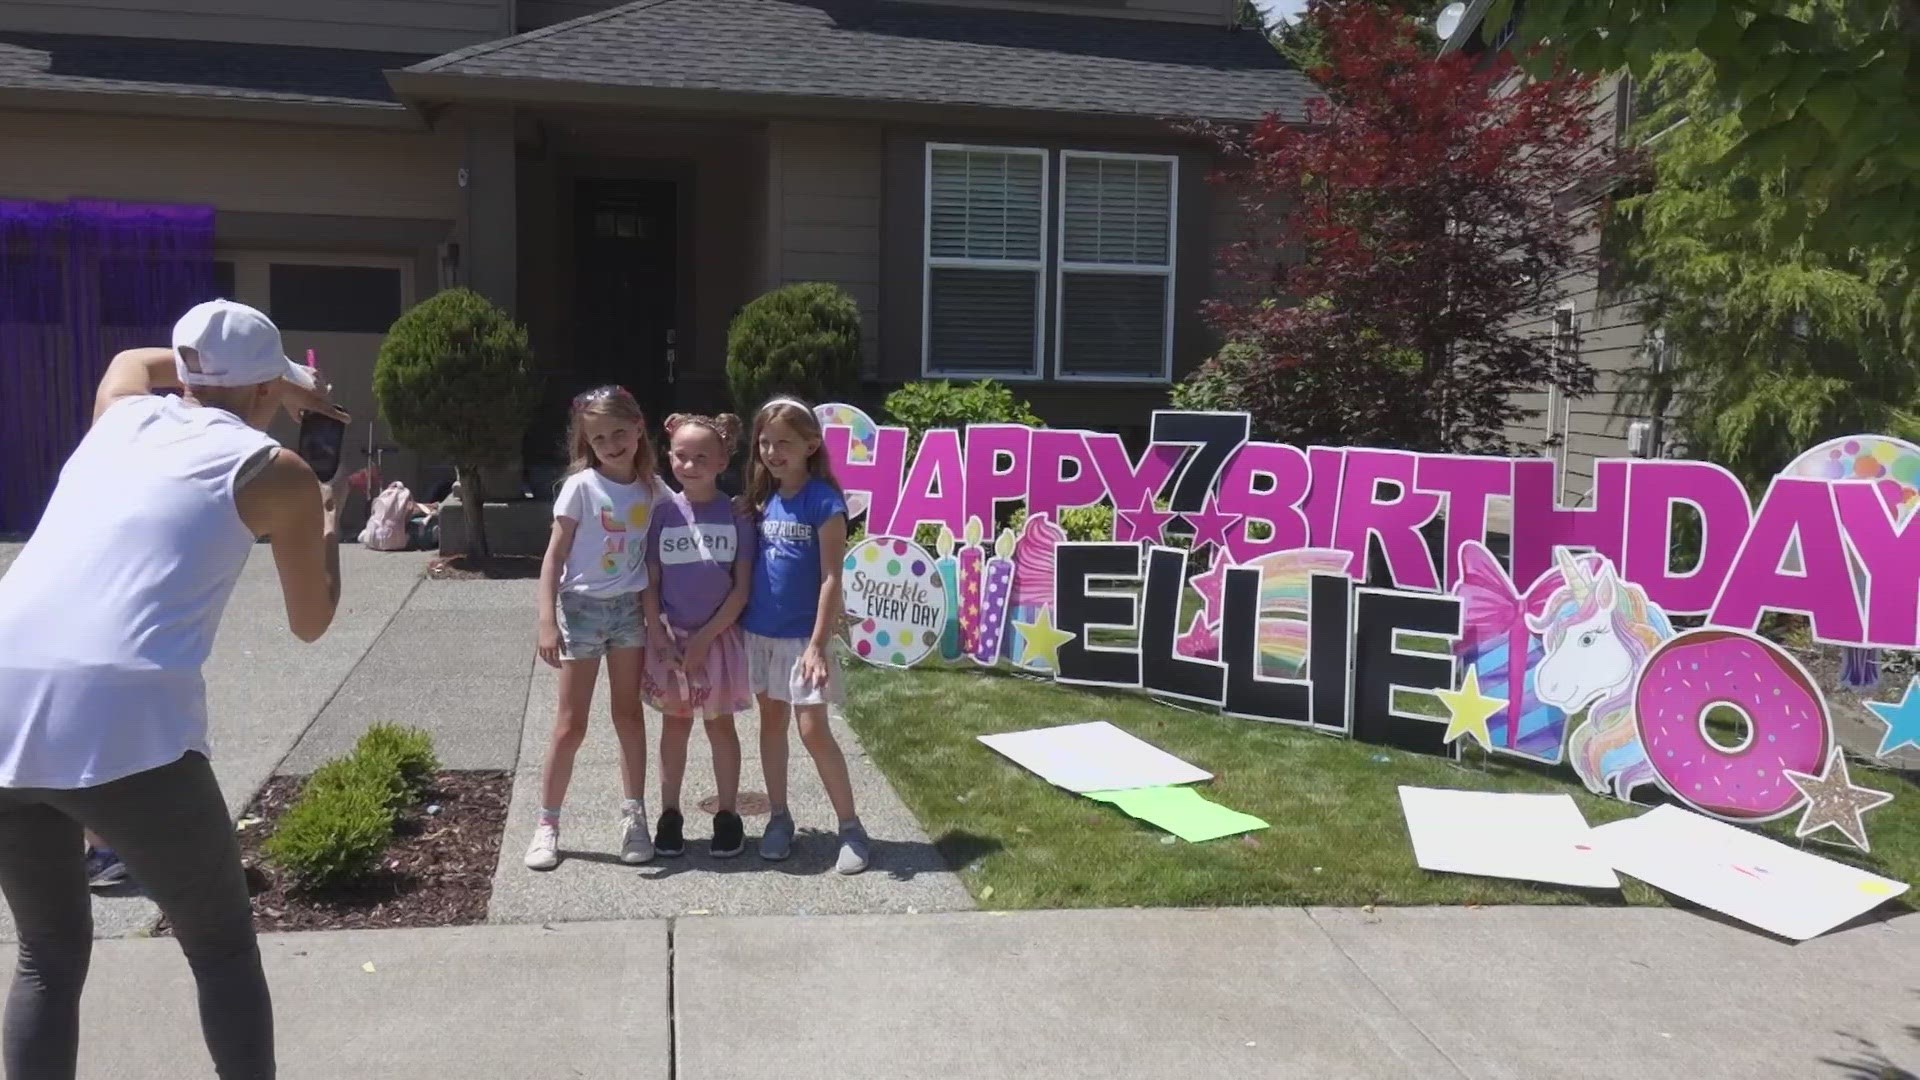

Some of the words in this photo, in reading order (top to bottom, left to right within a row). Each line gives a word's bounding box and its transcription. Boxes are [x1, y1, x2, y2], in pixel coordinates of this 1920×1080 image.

[823, 423, 1192, 543] HAPPY
[1150, 410, 1251, 515] 7
[1215, 439, 1920, 650] BIRTHDAY
[852, 571, 927, 604] Sparkle
[867, 595, 908, 621] EVERY
[911, 603, 939, 628] DAY
[1054, 541, 1464, 762] ELLIE
